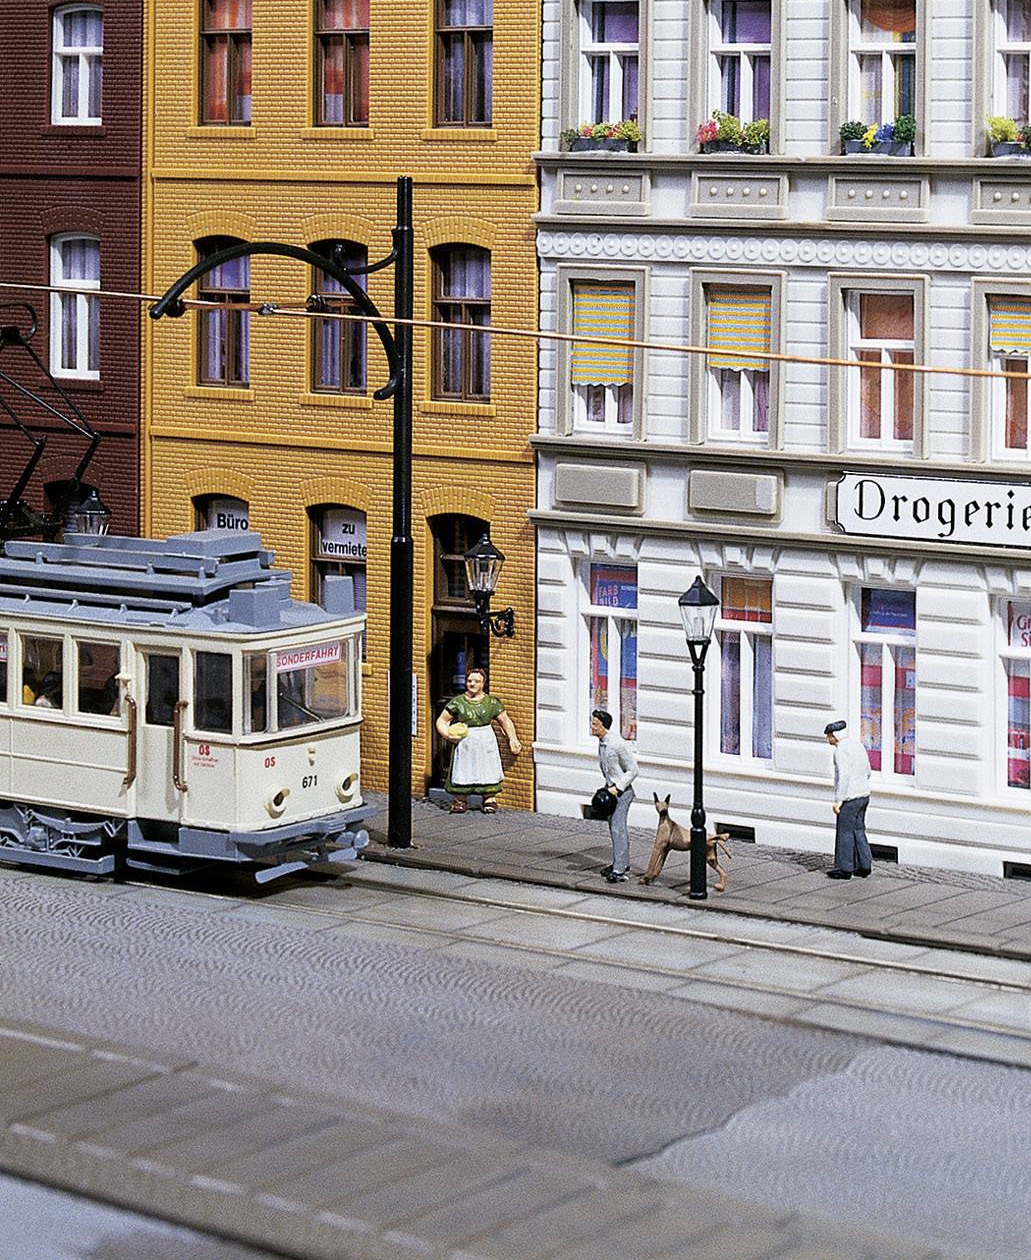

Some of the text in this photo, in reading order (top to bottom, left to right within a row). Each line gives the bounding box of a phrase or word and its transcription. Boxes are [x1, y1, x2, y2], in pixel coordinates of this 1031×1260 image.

[217, 513, 249, 531] Büro
[342, 523, 355, 535] zu
[264, 756, 276, 769] OS
[302, 774, 318, 789] 671
